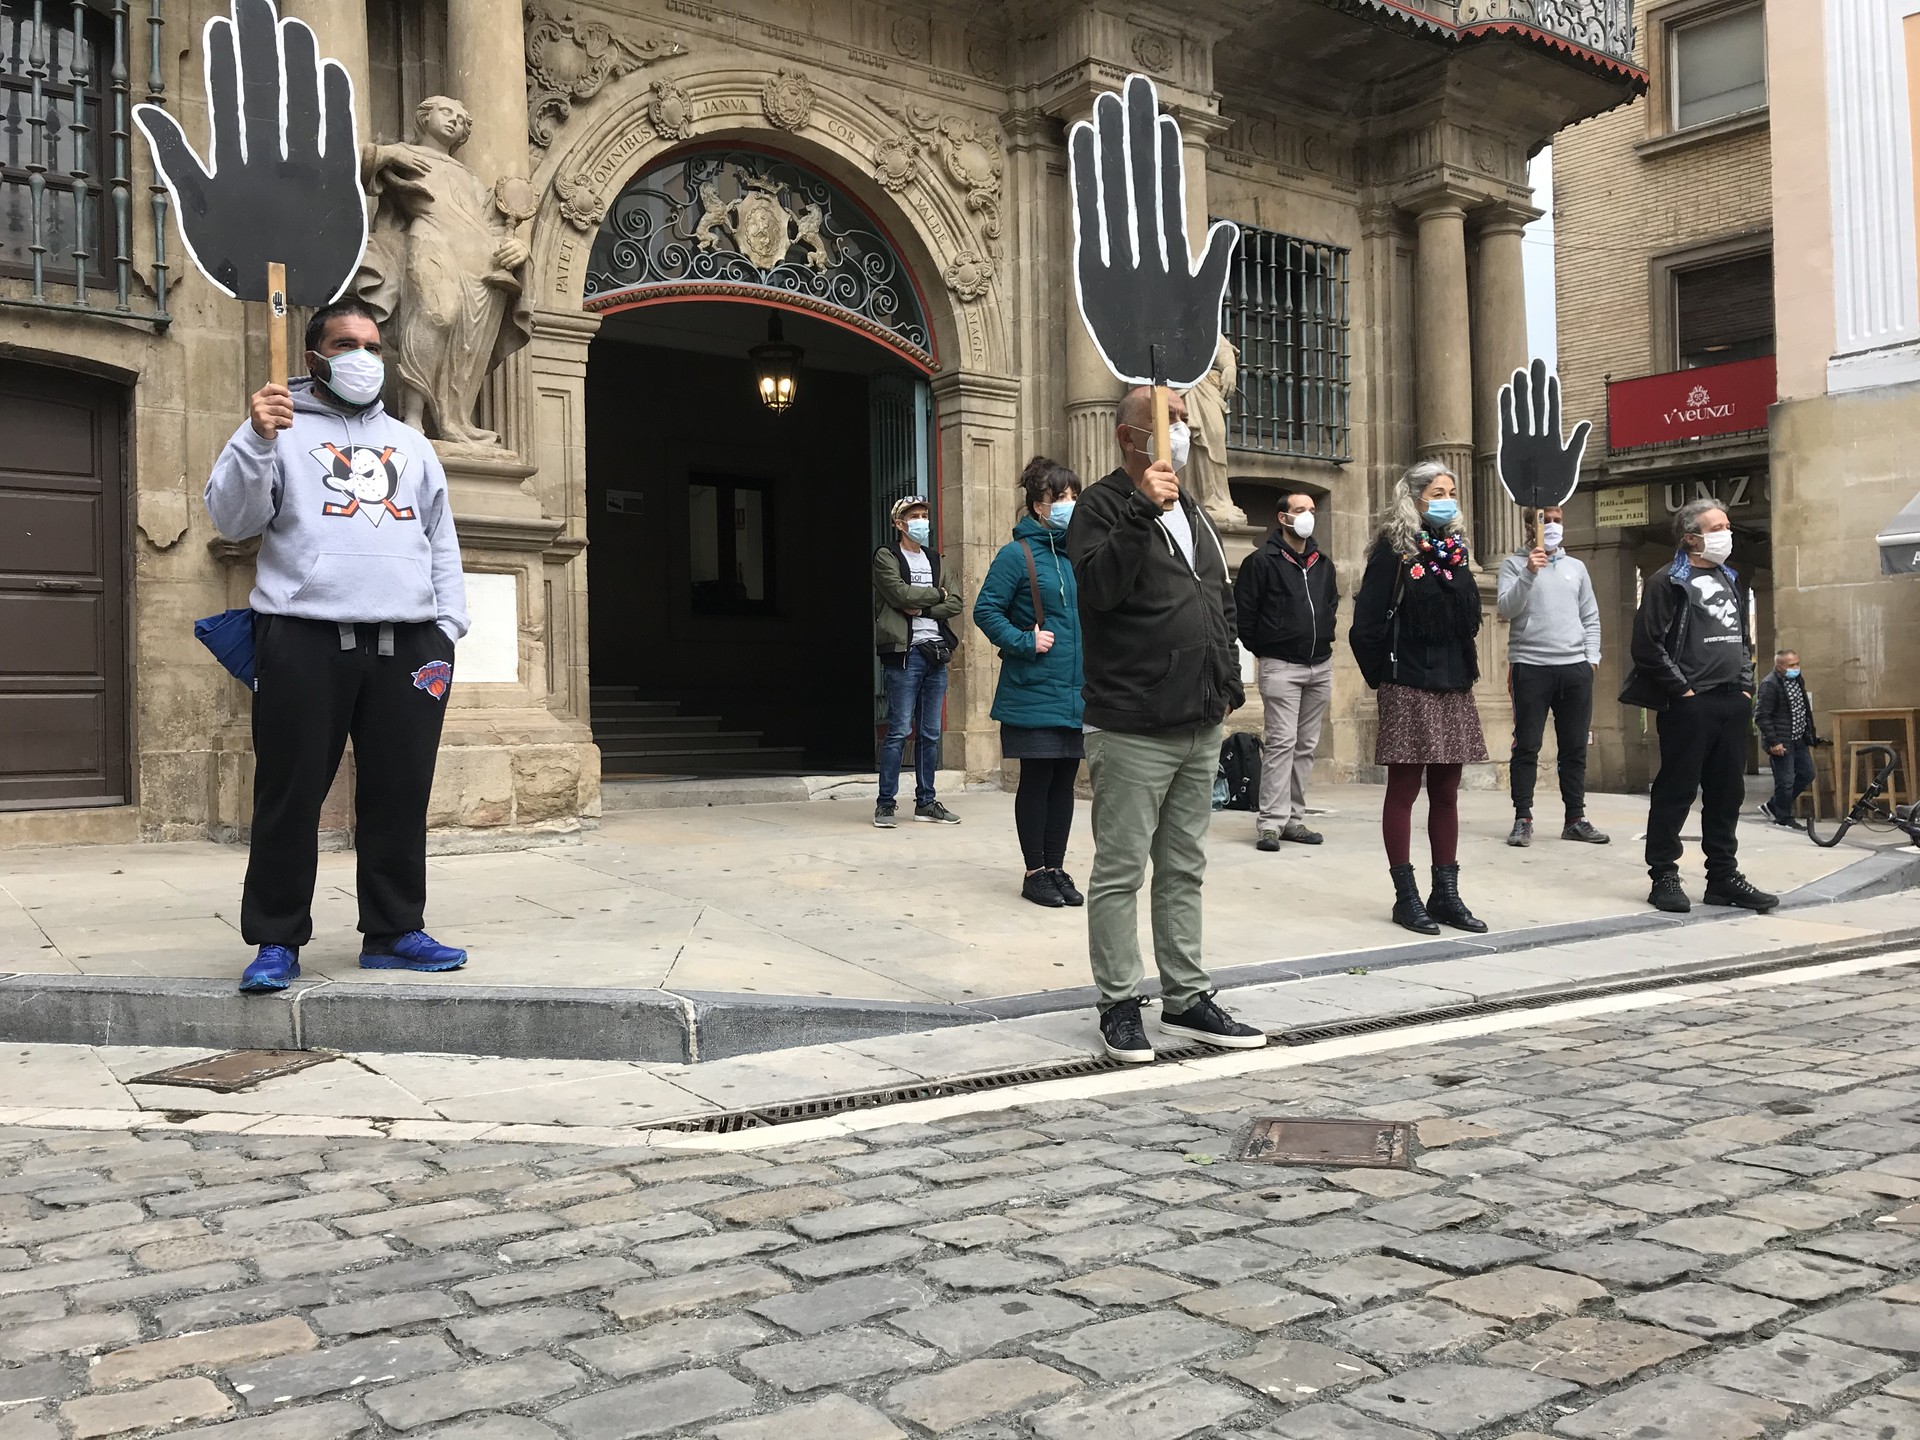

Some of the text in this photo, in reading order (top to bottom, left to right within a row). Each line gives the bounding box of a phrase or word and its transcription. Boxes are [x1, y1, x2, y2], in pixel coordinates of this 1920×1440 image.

[555, 98, 983, 362] PATET OMNIBUS JANVA COR VALDE MAGIS
